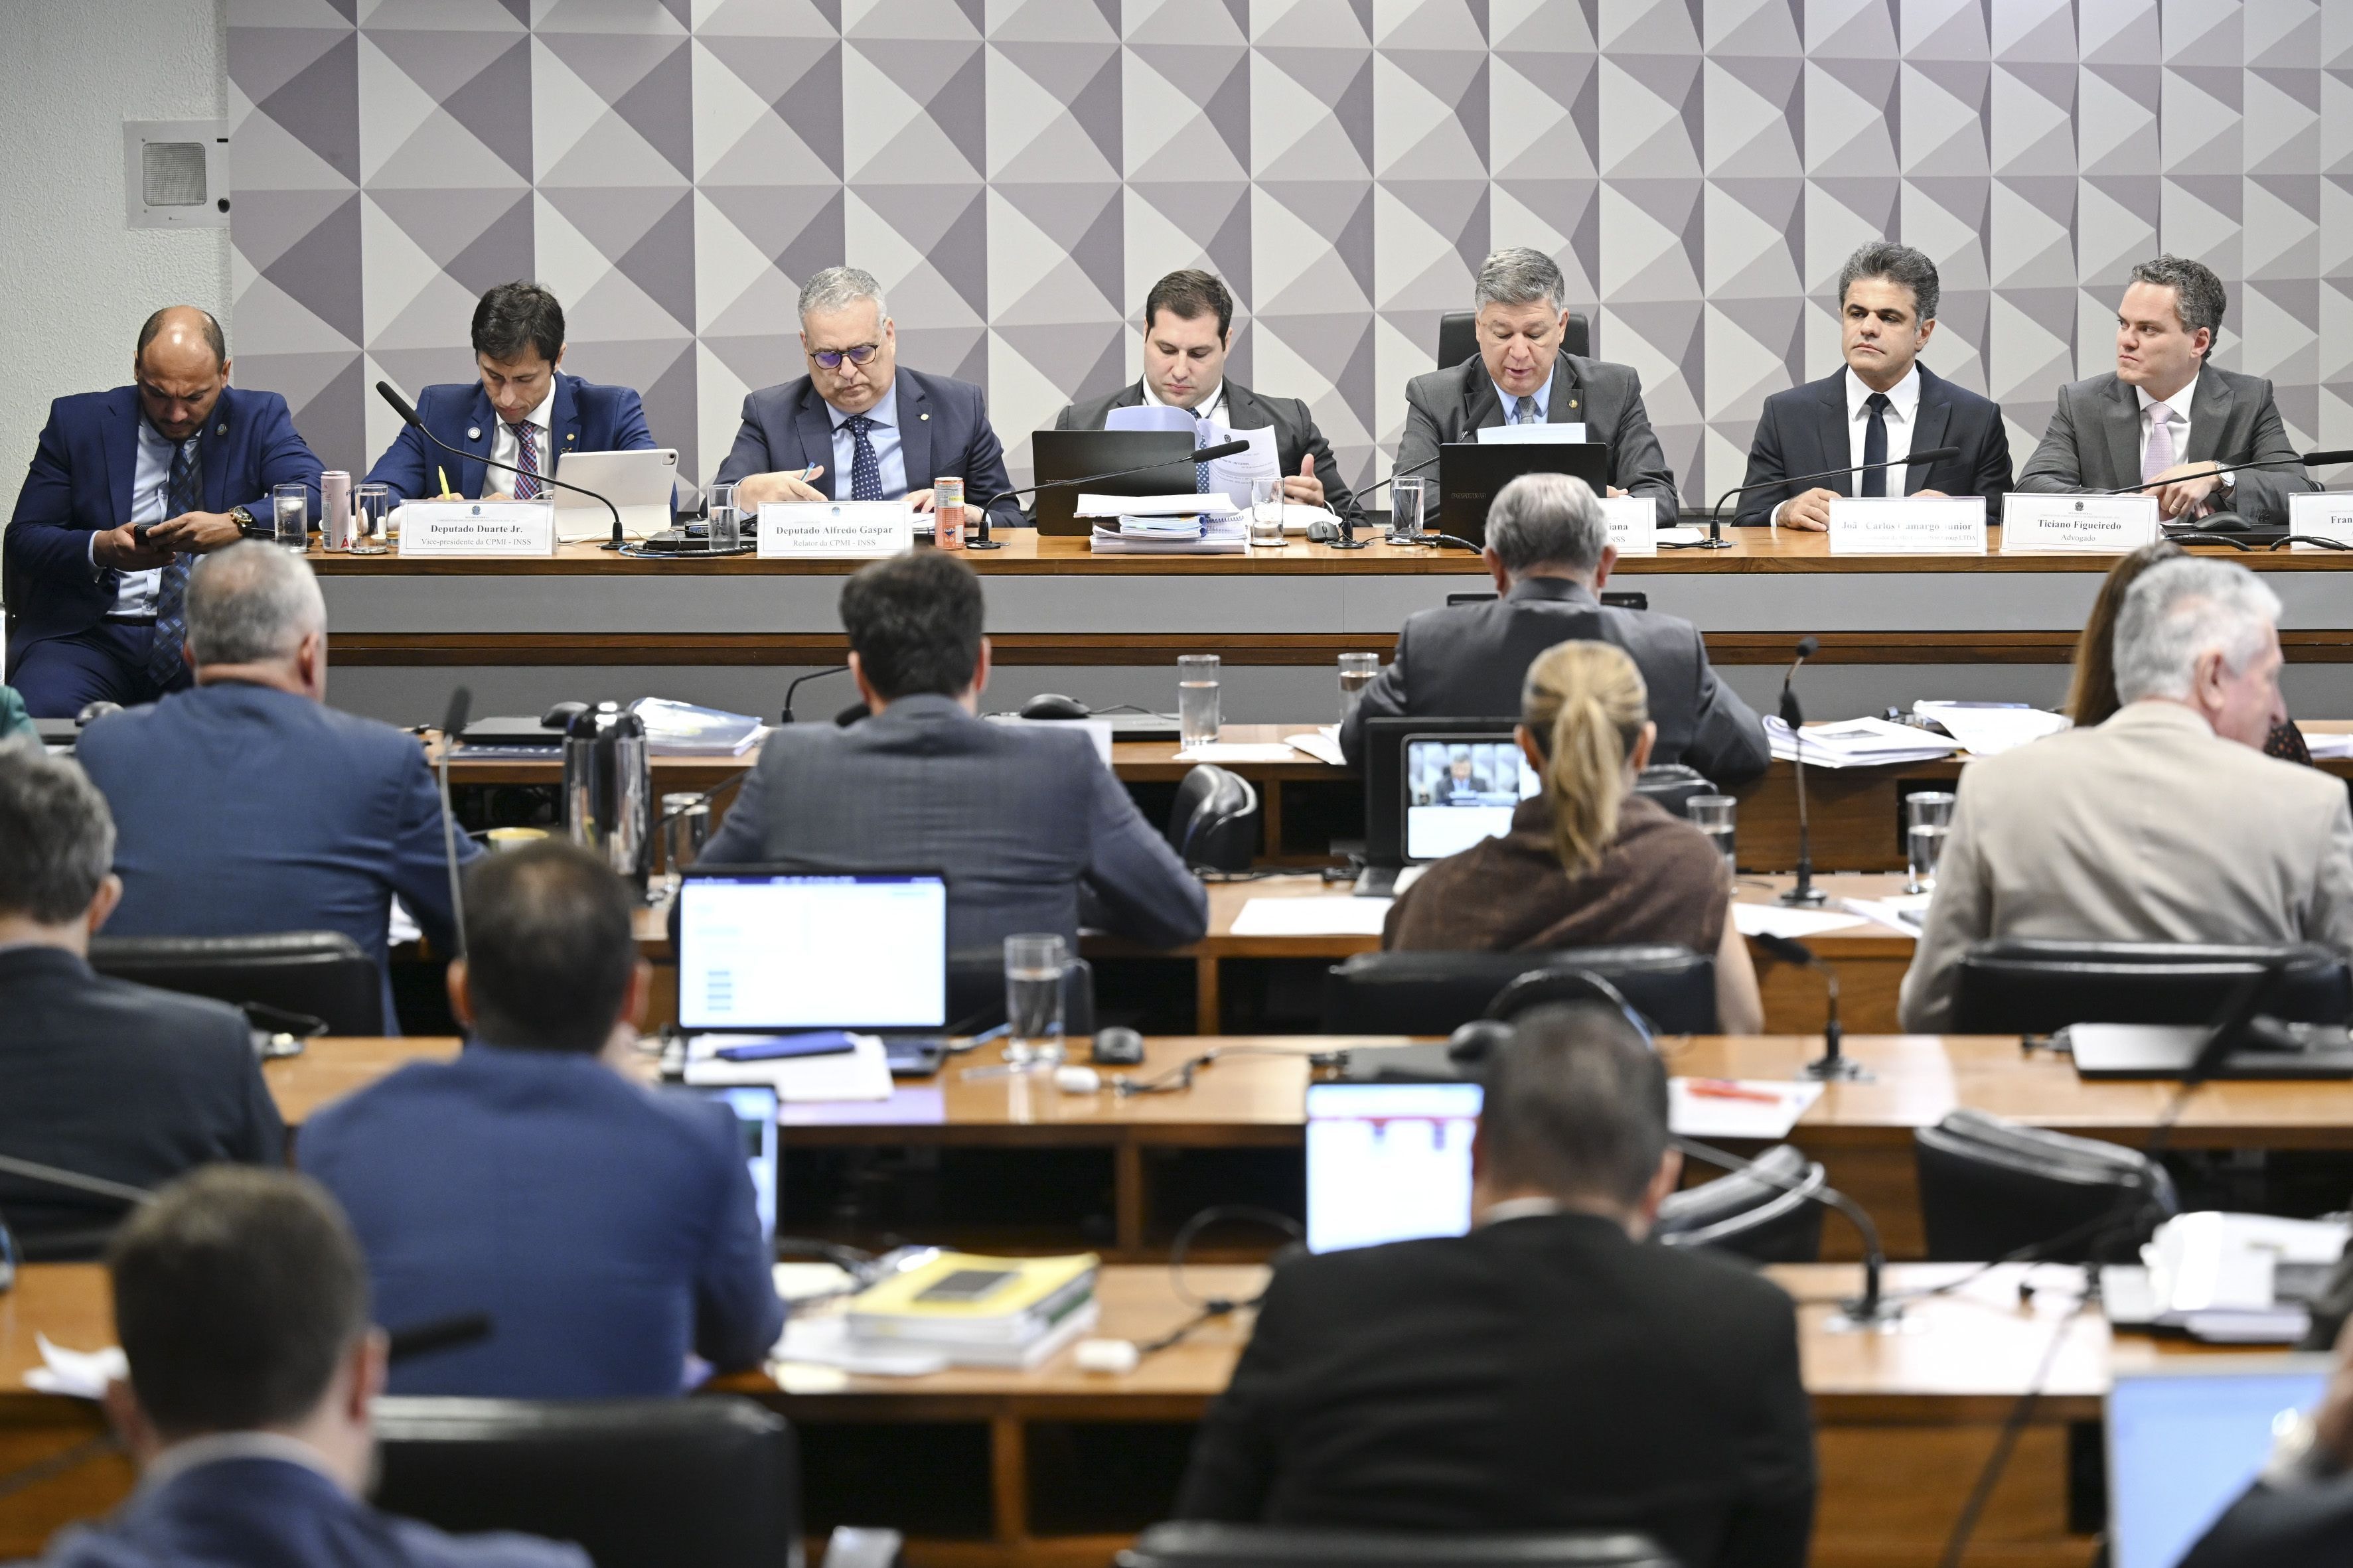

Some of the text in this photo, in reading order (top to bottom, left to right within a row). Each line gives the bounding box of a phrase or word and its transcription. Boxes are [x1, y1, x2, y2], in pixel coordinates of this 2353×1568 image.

[2038, 520, 2121, 530] Ticiano Figueiredo
[777, 526, 820, 535] Deputado
[860, 526, 893, 535] Gaspar
[421, 538, 474, 547] Vice-presidente
[2061, 534, 2095, 543] Advogado
